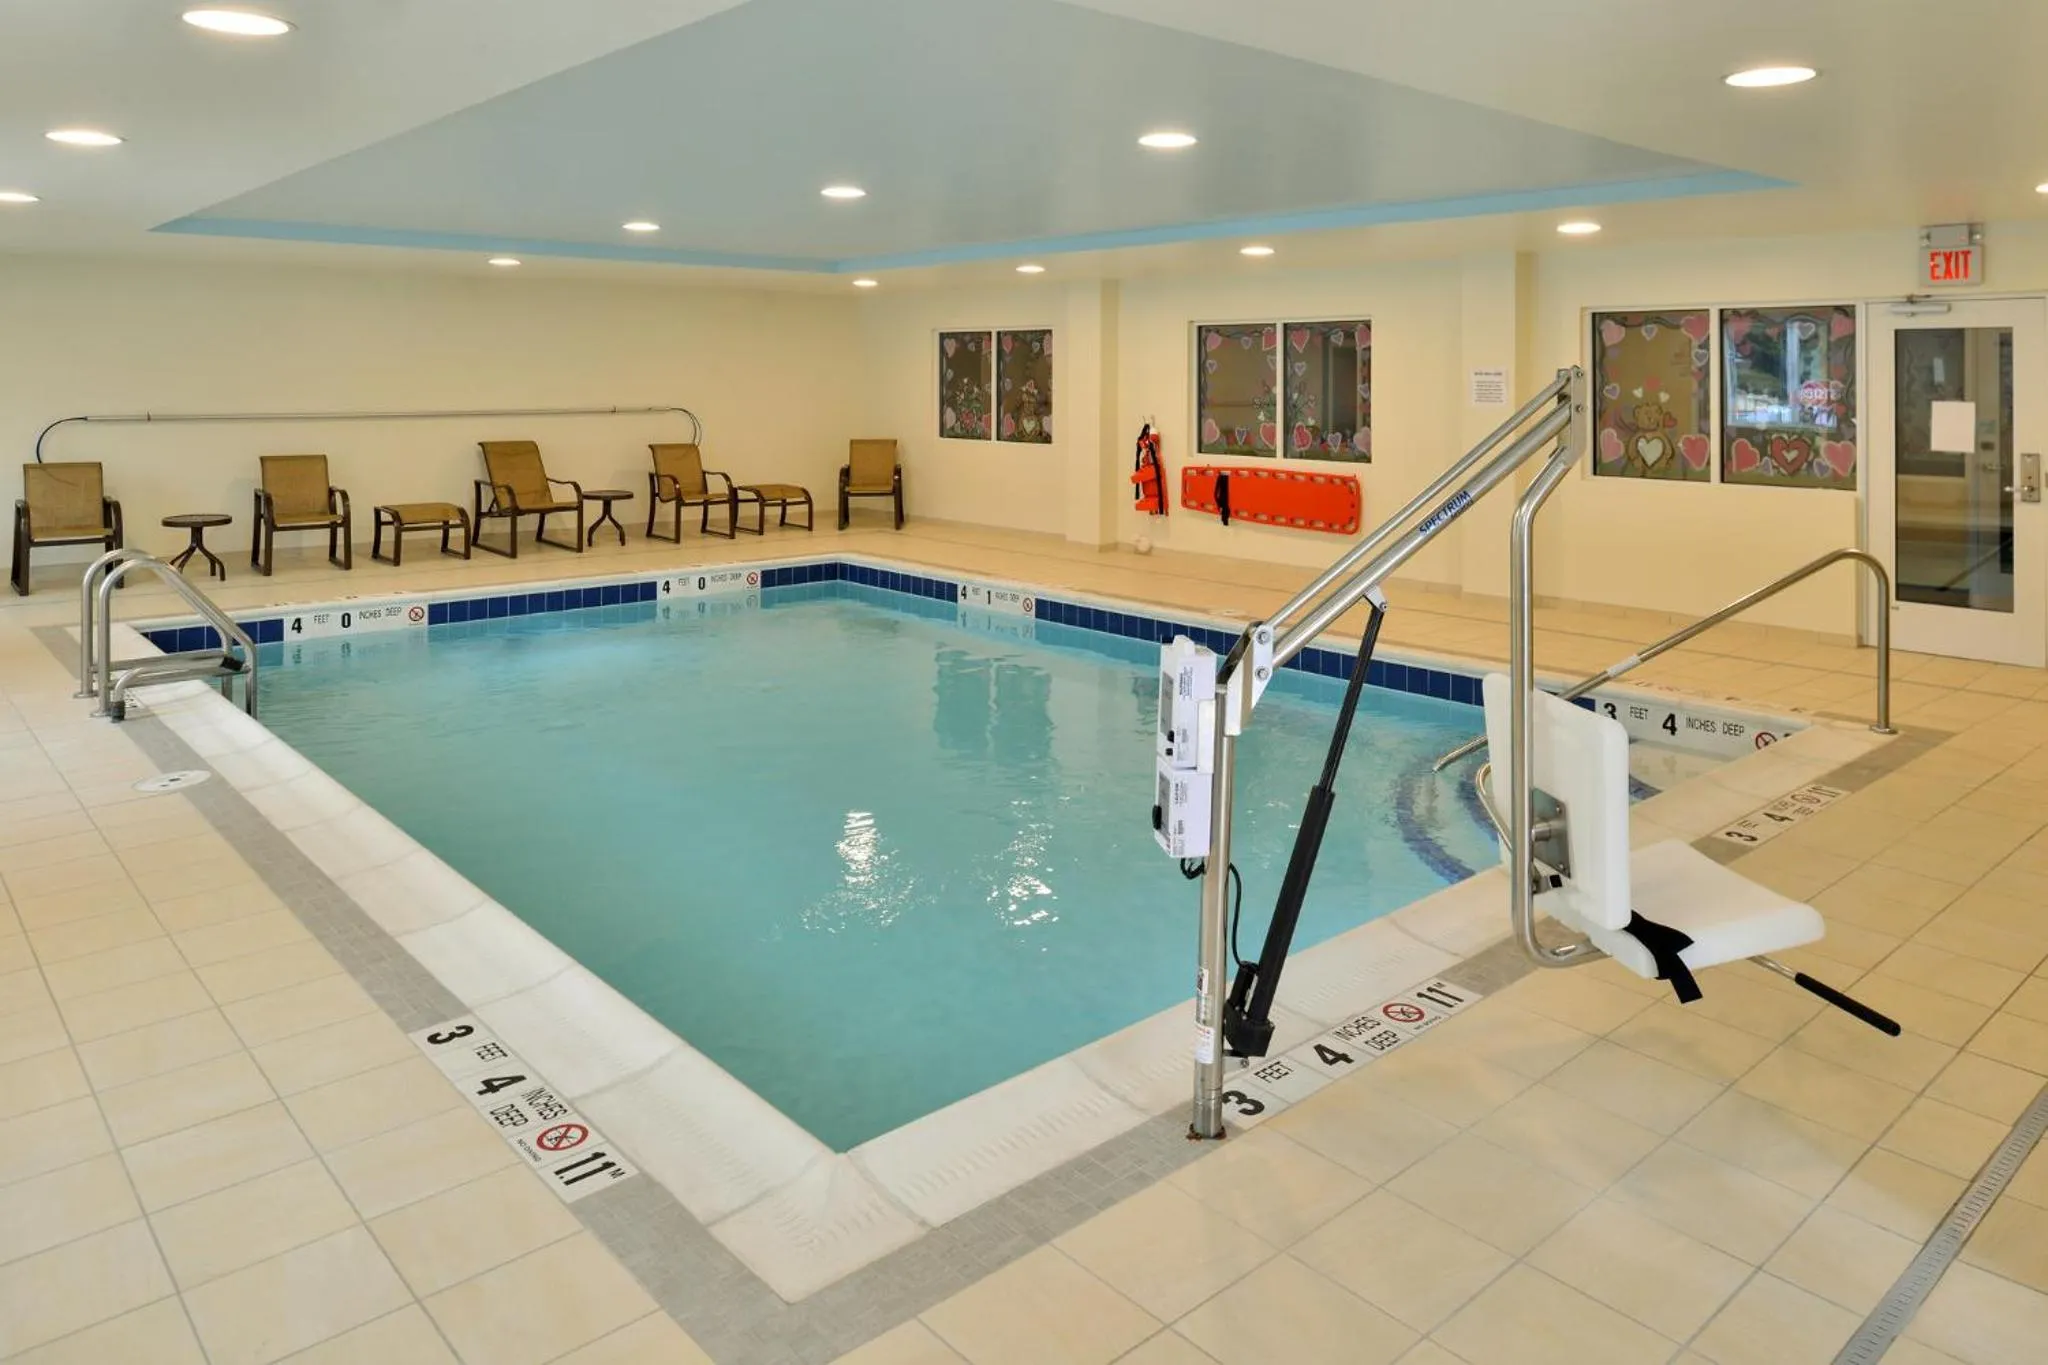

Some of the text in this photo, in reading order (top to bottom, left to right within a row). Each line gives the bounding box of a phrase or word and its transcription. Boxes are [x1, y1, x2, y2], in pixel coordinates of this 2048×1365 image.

[1929, 250, 1972, 281] EXIT
[1419, 490, 1473, 533] SPECTRUM
[661, 580, 671, 594] 4
[697, 577, 706, 590] 0
[960, 585, 967, 600] 4
[291, 617, 303, 634] 4
[313, 614, 330, 625] FEET
[341, 612, 352, 628] 0
[358, 609, 382, 620] INCHES
[1603, 702, 1745, 737] 3 FEET 4 INCHES DEEP
[1725, 831, 1759, 842] 3
[1364, 1029, 1401, 1051] DEEP
[426, 1024, 568, 1121] 3 FEET 4 INCHES
[1221, 1015, 1383, 1116] 3 FEET 4 INCHES
[489, 1103, 529, 1128] DEEP
